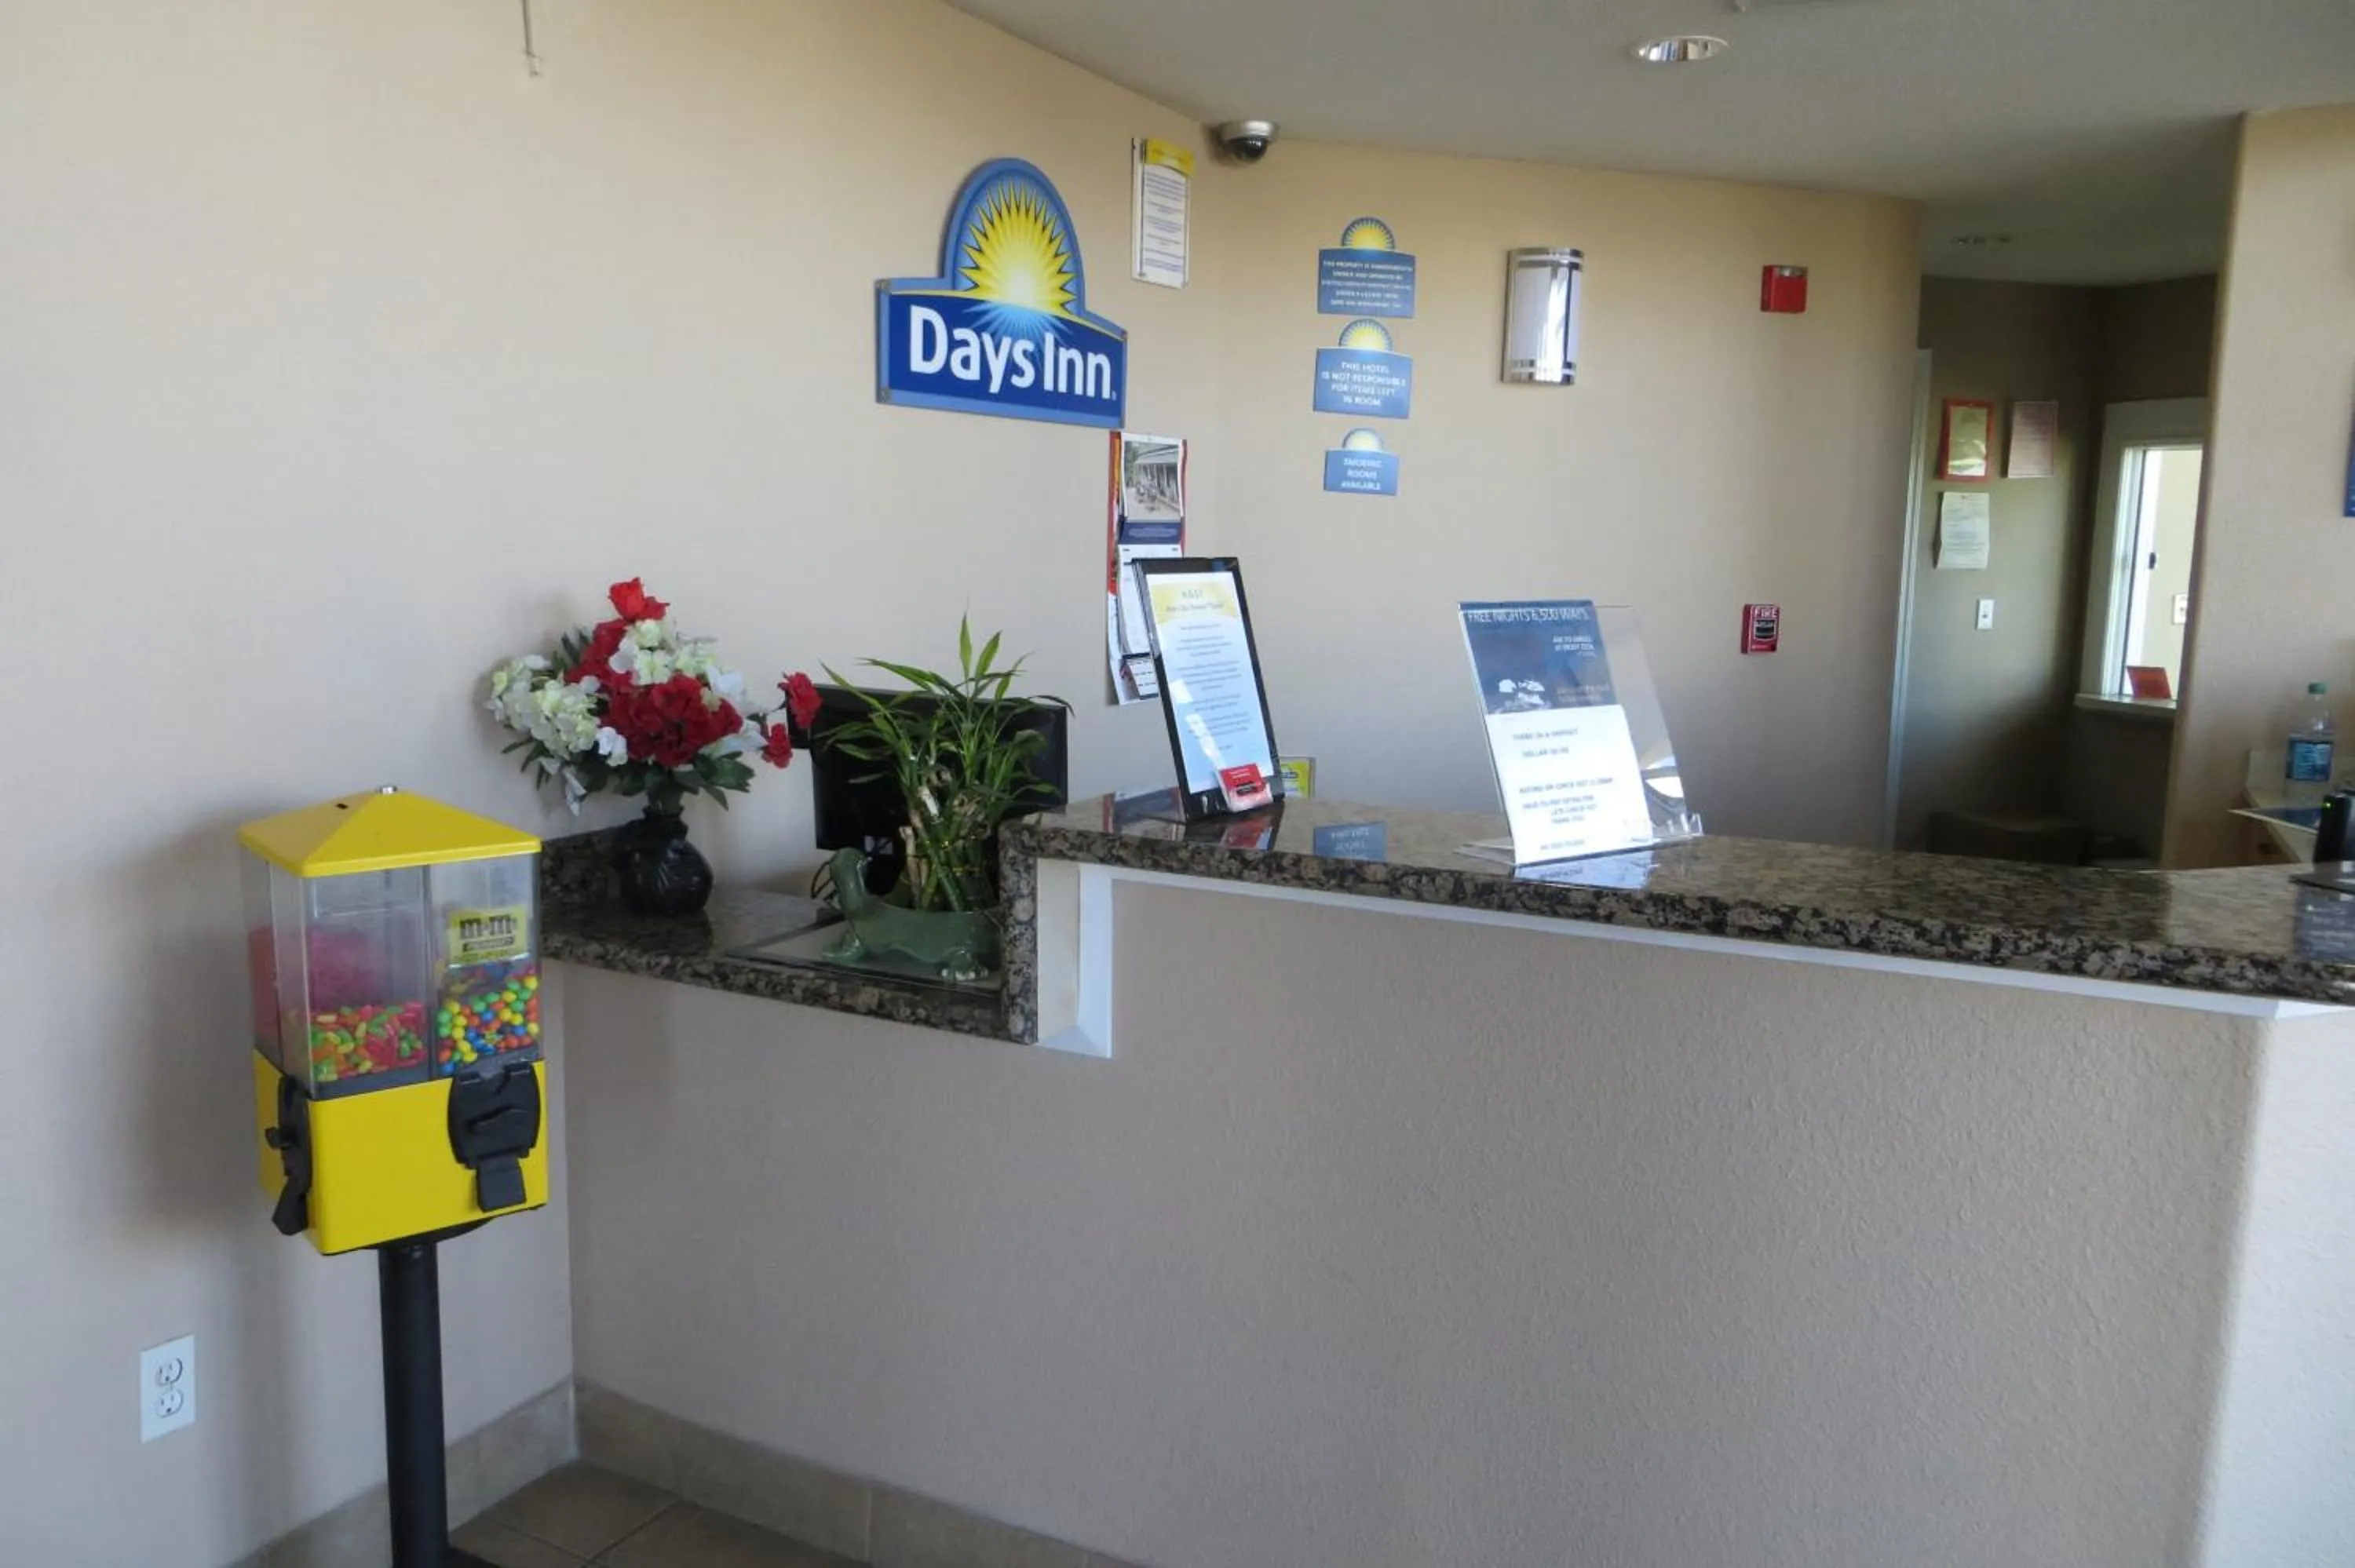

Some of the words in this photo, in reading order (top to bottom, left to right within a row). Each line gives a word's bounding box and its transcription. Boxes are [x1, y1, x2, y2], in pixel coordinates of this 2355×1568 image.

[910, 304, 1035, 394] Days
[1043, 332, 1112, 401] Inn
[1341, 361, 1360, 371] THIS
[1362, 363, 1389, 374] HOTEL
[1321, 370, 1330, 380] IS
[1331, 372, 1351, 382] NOT
[1331, 382, 1349, 392] FOR
[1354, 396, 1381, 406] ROOM
[1468, 611, 1492, 622] FREE
[1493, 609, 1531, 622] NIGHTS
